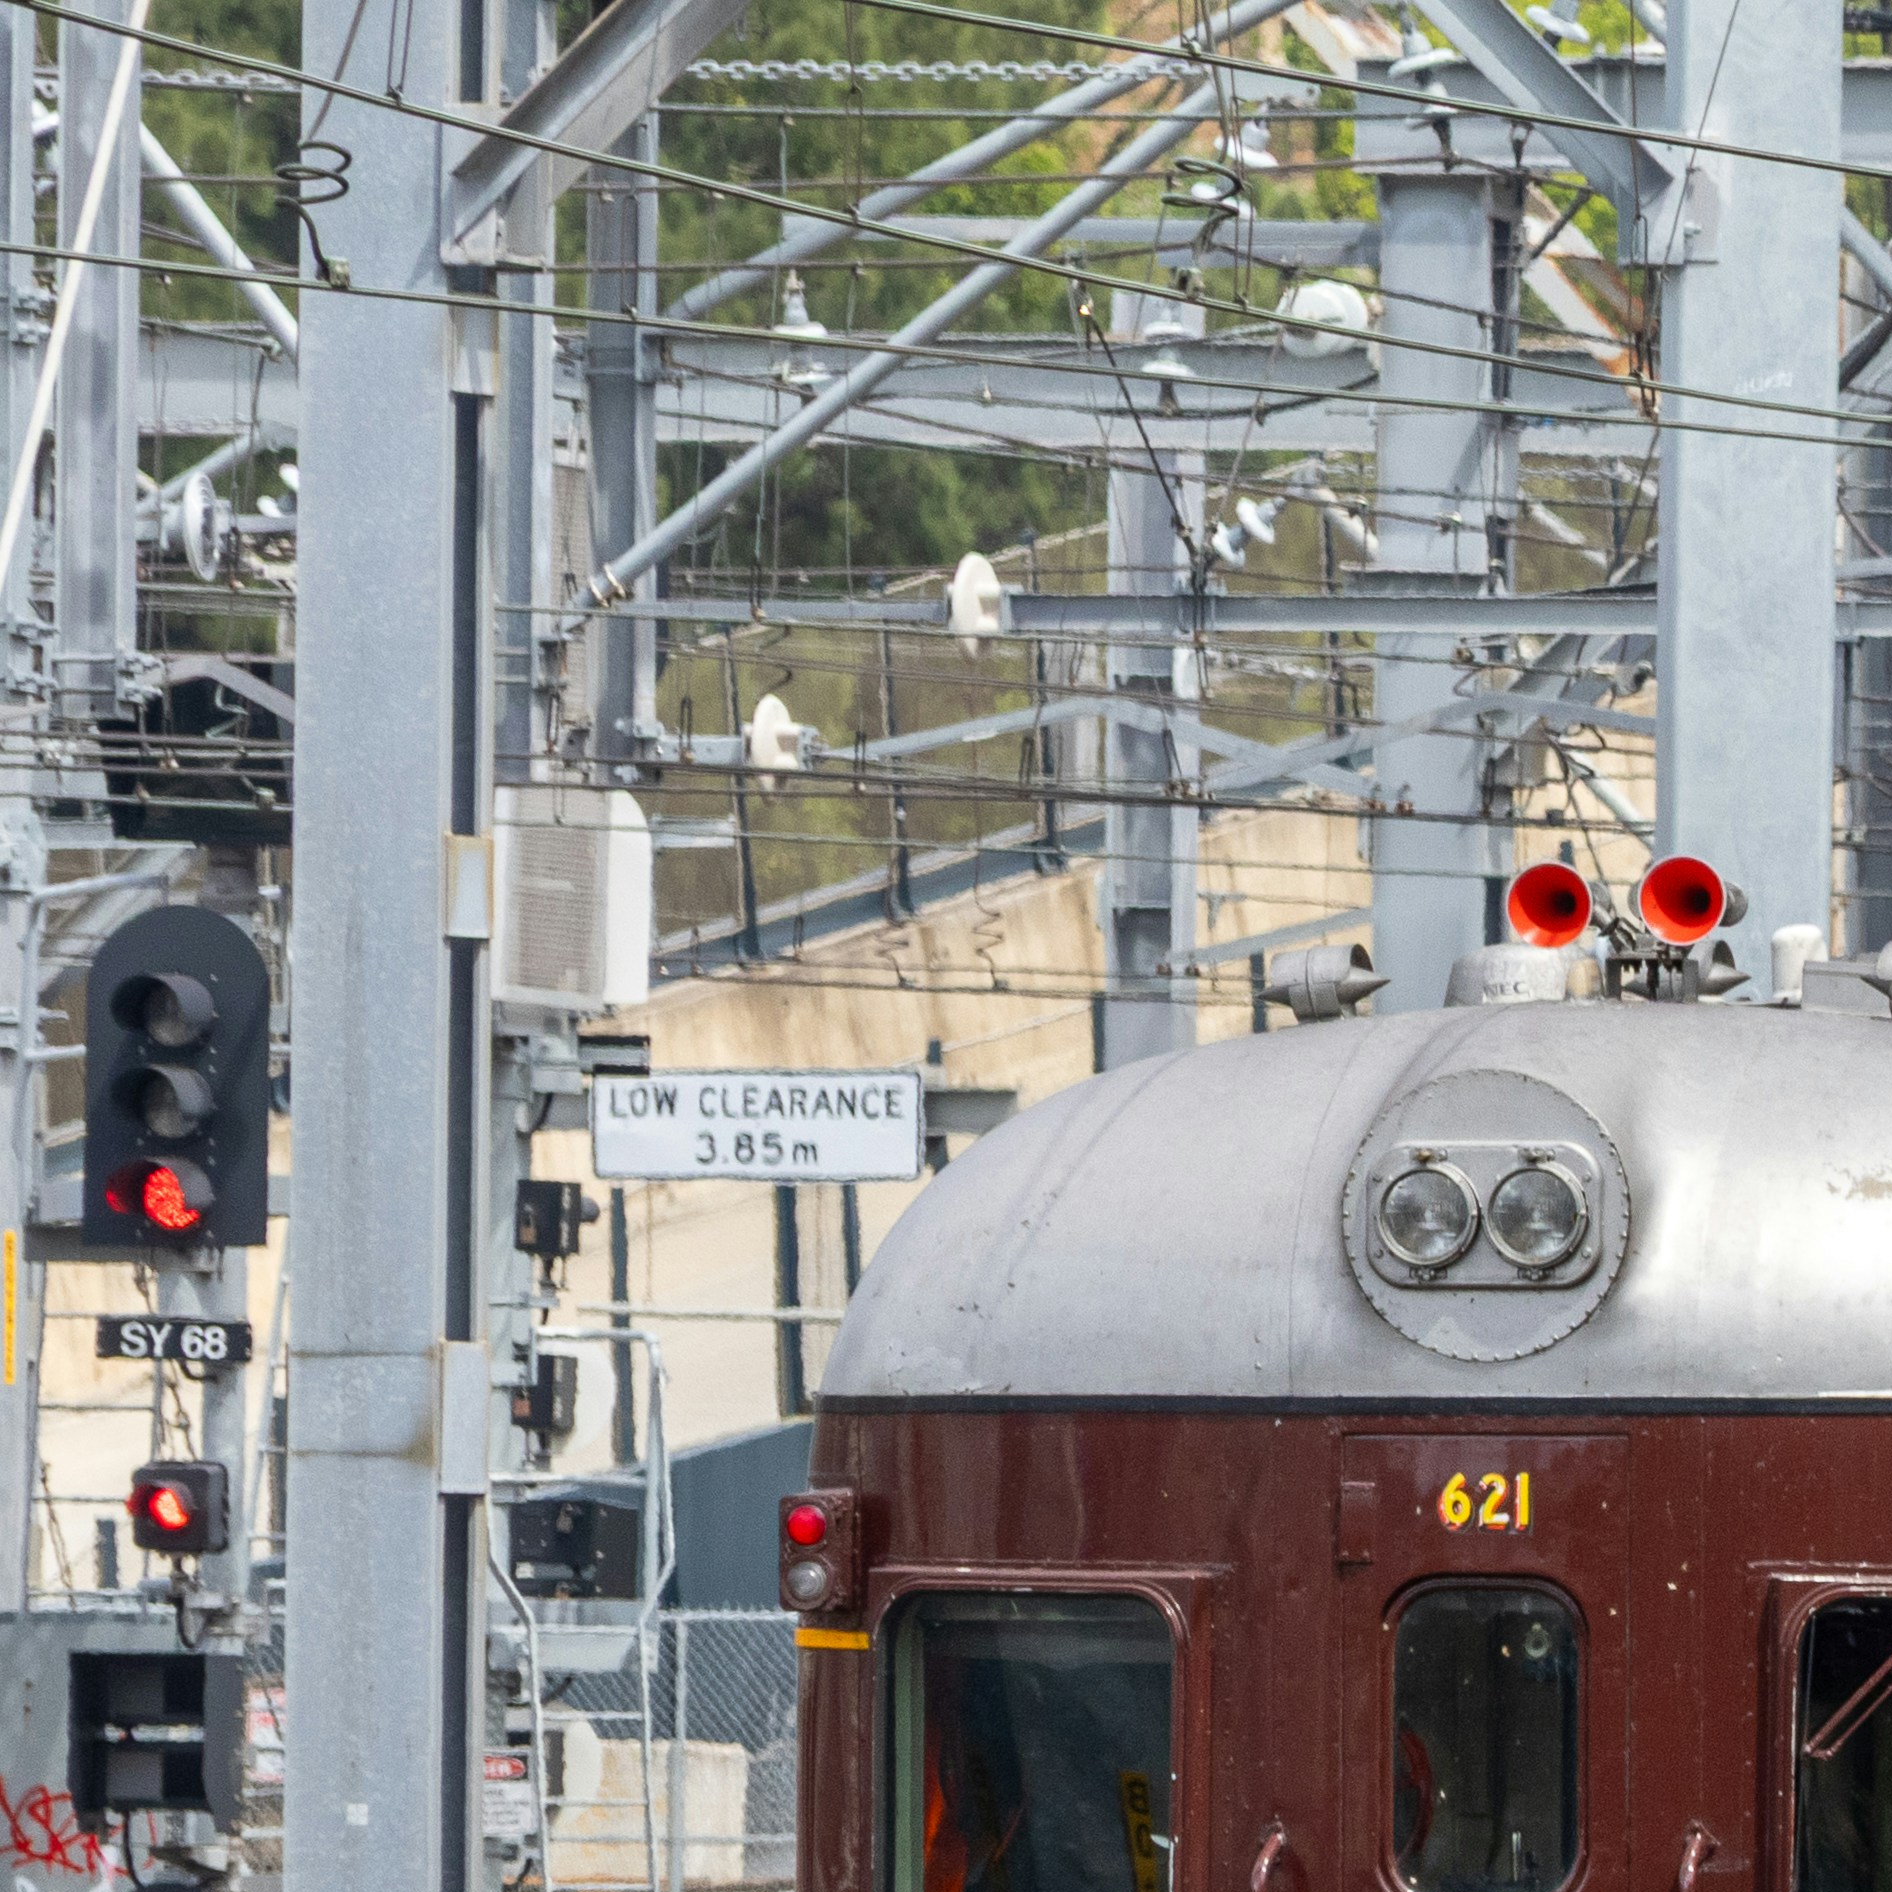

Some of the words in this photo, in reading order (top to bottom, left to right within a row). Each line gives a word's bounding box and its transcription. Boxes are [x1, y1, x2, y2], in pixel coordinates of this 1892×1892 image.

[610, 1086, 678, 1119] LOW
[699, 1085, 906, 1120] CLEARANCE
[120, 1320, 172, 1358] SY
[181, 1324, 229, 1361] 68
[1438, 1471, 1531, 1531] 621
